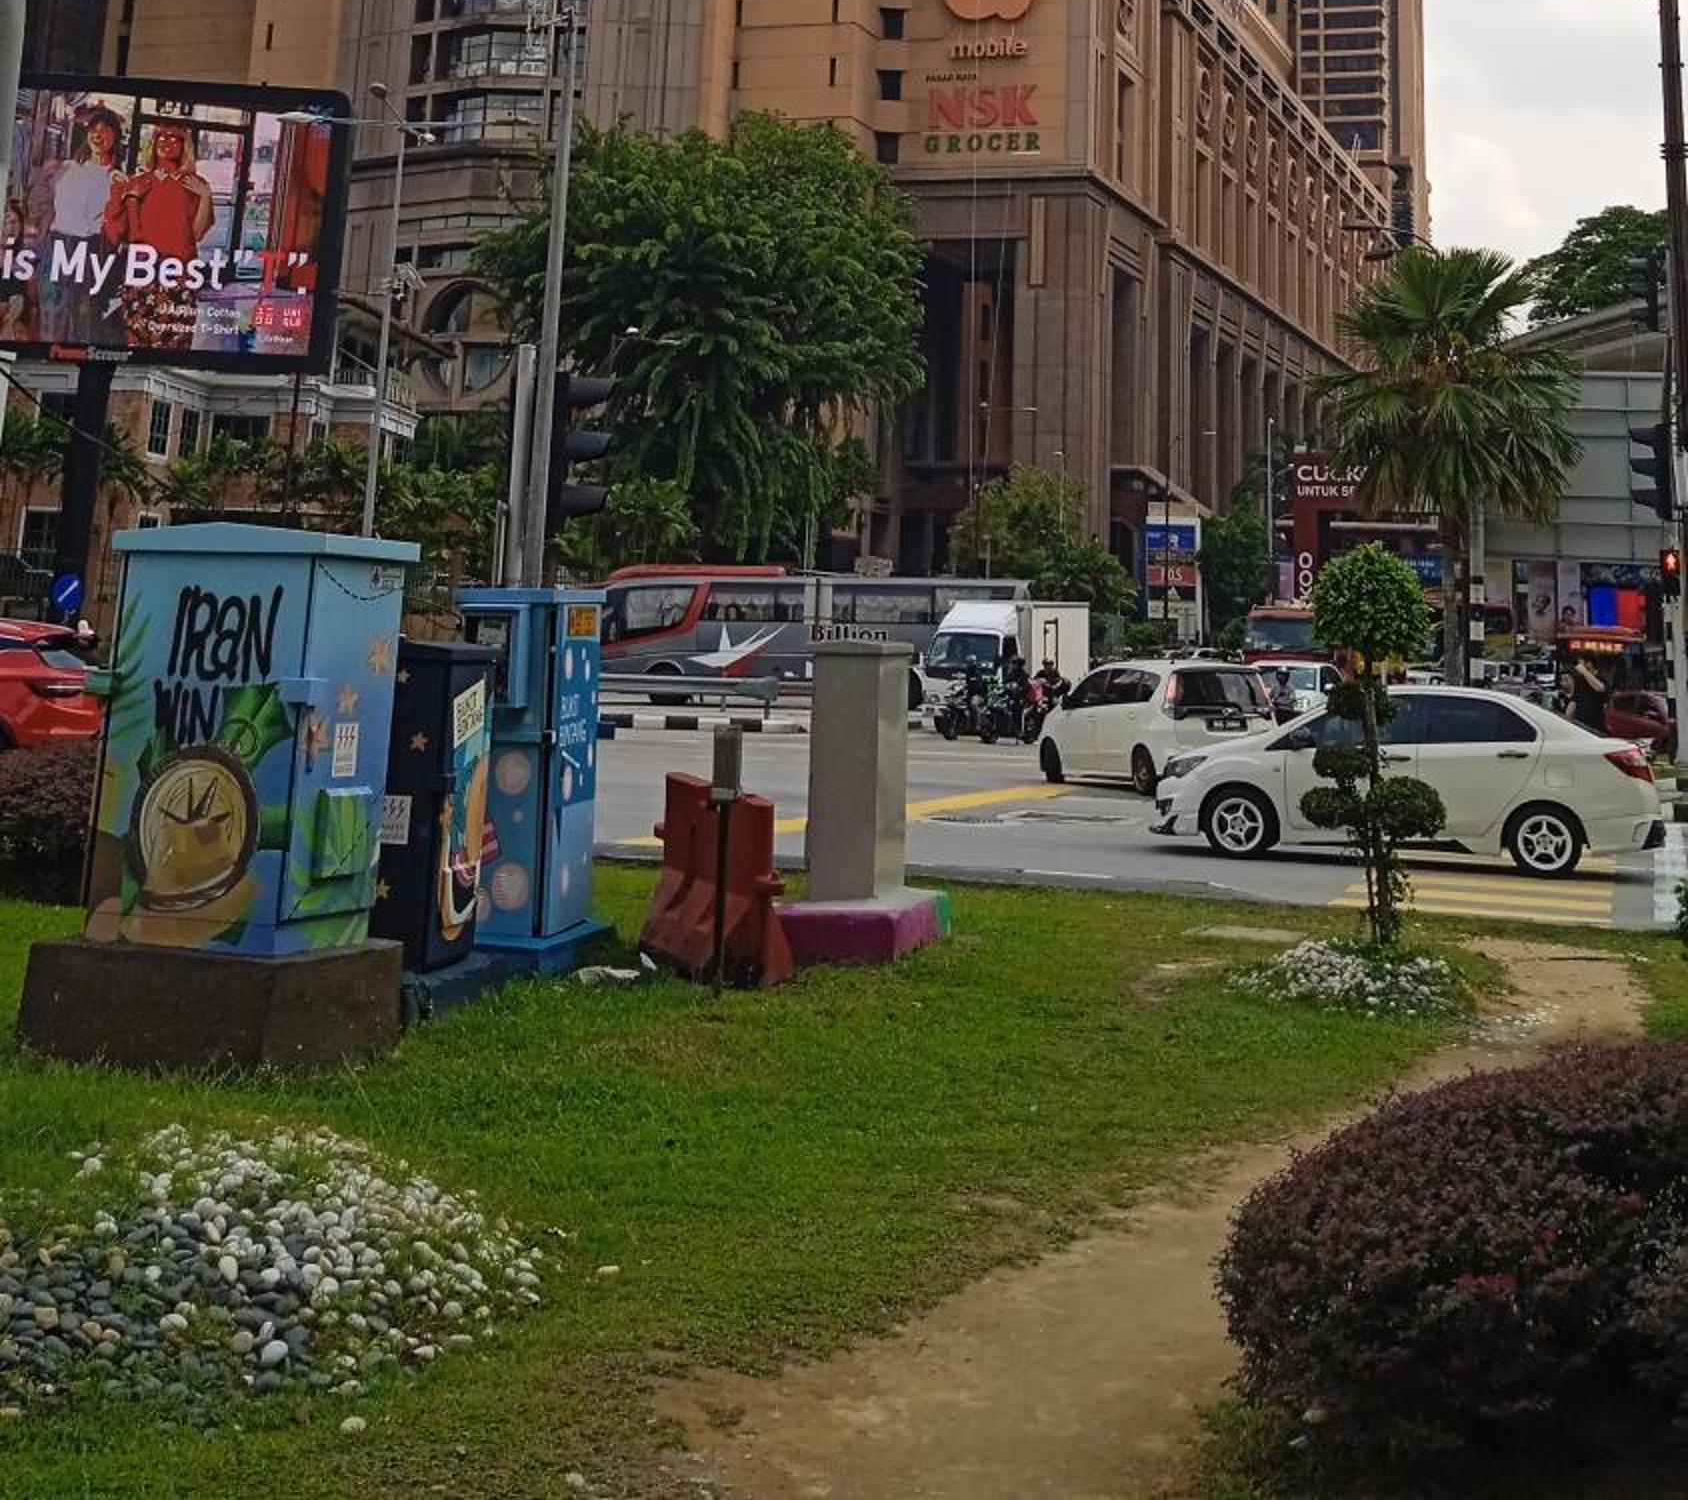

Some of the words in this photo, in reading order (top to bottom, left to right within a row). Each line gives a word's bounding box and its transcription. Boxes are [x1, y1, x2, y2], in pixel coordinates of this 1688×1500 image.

[951, 37, 1028, 60] mobile
[928, 84, 1039, 131] NSK
[925, 132, 1041, 154] GROCER
[1, 237, 36, 280] is
[51, 239, 117, 296] My
[124, 242, 226, 291] Best
[1297, 485, 1339, 497] UNTUK
[810, 623, 888, 643] Billion
[153, 678, 220, 743] WIN
